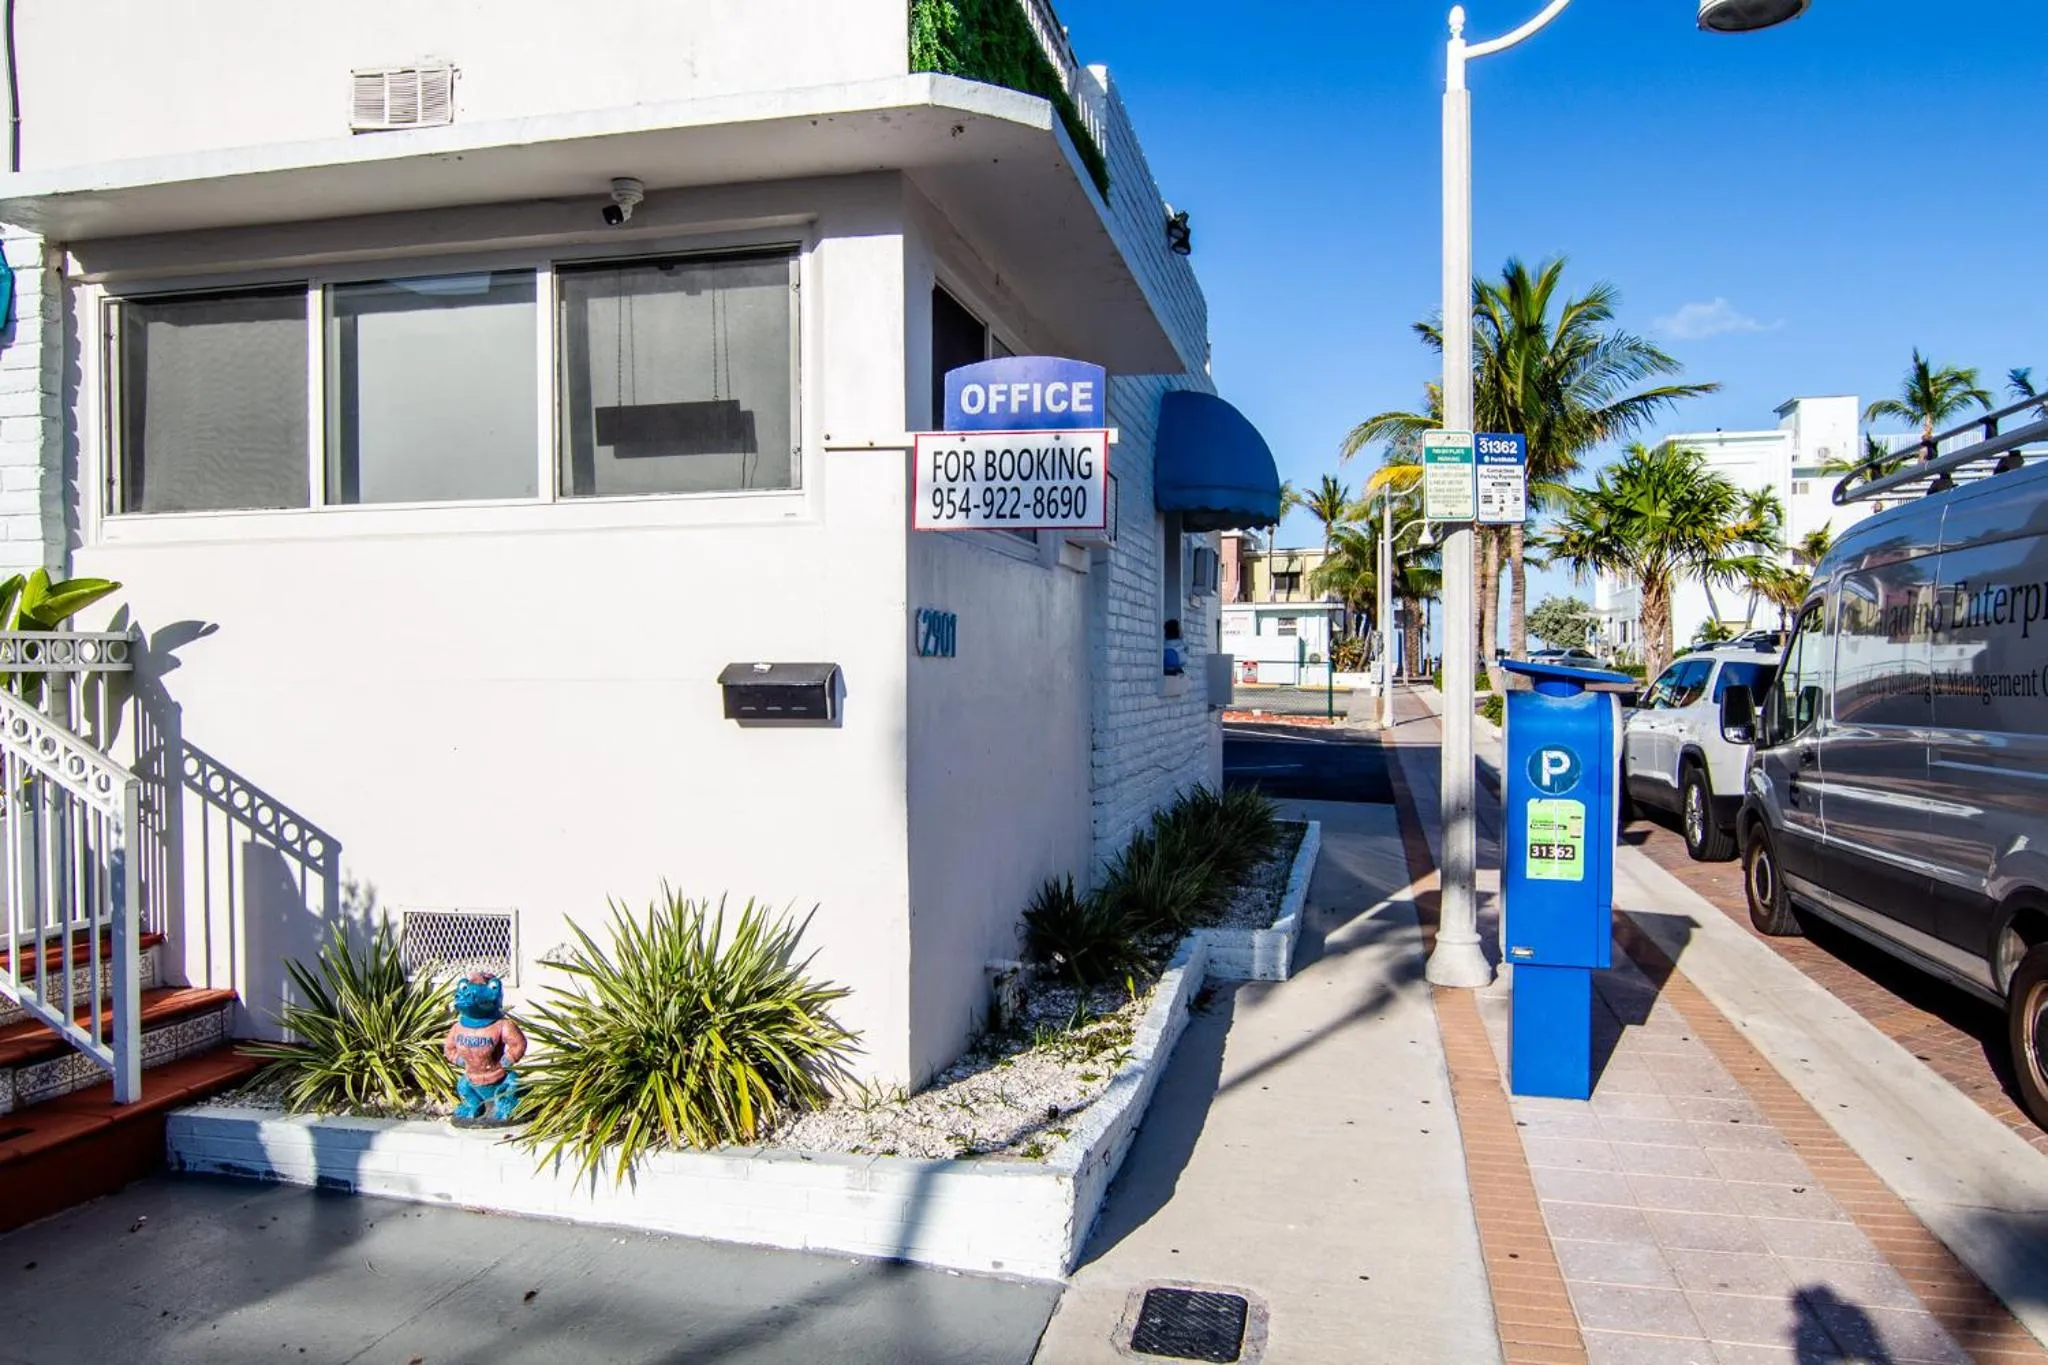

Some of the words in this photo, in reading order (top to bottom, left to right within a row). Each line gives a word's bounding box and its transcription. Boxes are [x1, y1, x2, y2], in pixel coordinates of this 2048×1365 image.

[960, 381, 1093, 415] OFFICE
[932, 450, 977, 483] FOR
[984, 447, 1093, 482] BOOKING
[1479, 440, 1518, 454] 31362
[932, 486, 1087, 520] 954-922-8690
[1866, 590, 1943, 637] Paladino
[921, 608, 957, 658] 2901
[1947, 667, 2038, 705] Management
[1541, 750, 1571, 786] P
[1531, 845, 1574, 858] 31362
